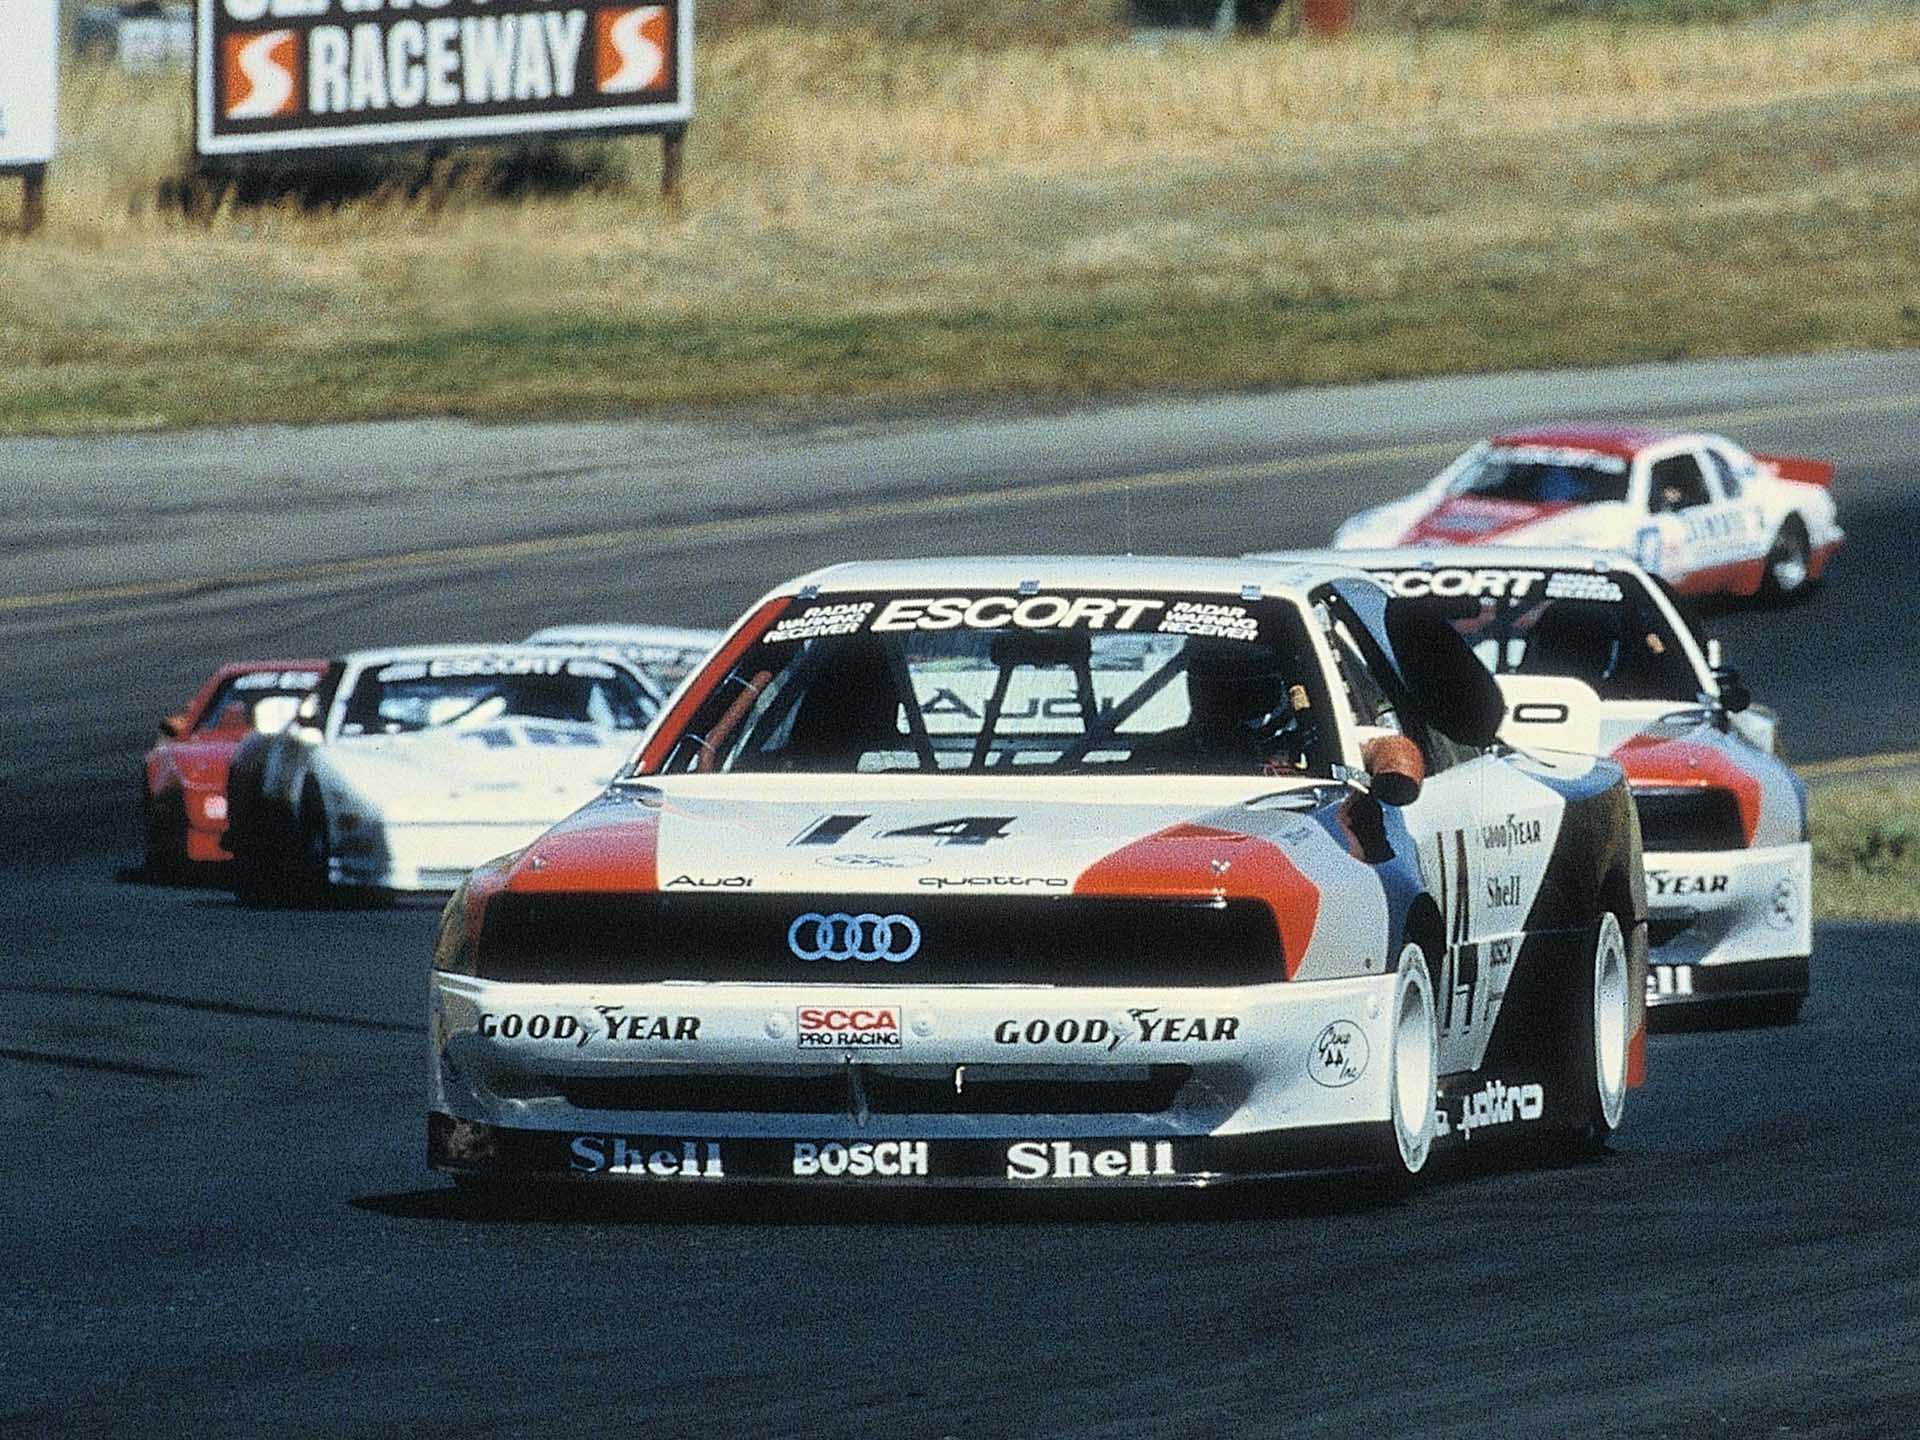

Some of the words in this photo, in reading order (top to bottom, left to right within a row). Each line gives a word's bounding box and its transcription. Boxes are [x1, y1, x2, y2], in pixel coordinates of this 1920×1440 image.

[309, 10, 587, 115] RACEWAY
[1376, 570, 1546, 598] CORT
[777, 613, 867, 630] WARNING
[803, 602, 875, 618] RADAR
[870, 597, 1165, 632] ESCORT
[1165, 610, 1259, 630] WARNING
[1173, 602, 1247, 618] RADAR
[762, 622, 860, 643] RECEIVER
[1158, 620, 1259, 641] RECEIVER
[787, 815, 1018, 848] 14
[666, 874, 755, 888] Audi
[918, 876, 1068, 891] quattro
[1487, 874, 1520, 908] Shell
[800, 1008, 897, 1031] SCCA
[800, 1033, 833, 1046] PRO
[838, 1033, 899, 1046] RACING
[570, 1136, 724, 1177] Shell
[793, 1141, 929, 1176] BOSCH
[1006, 1141, 1175, 1180] Shell
